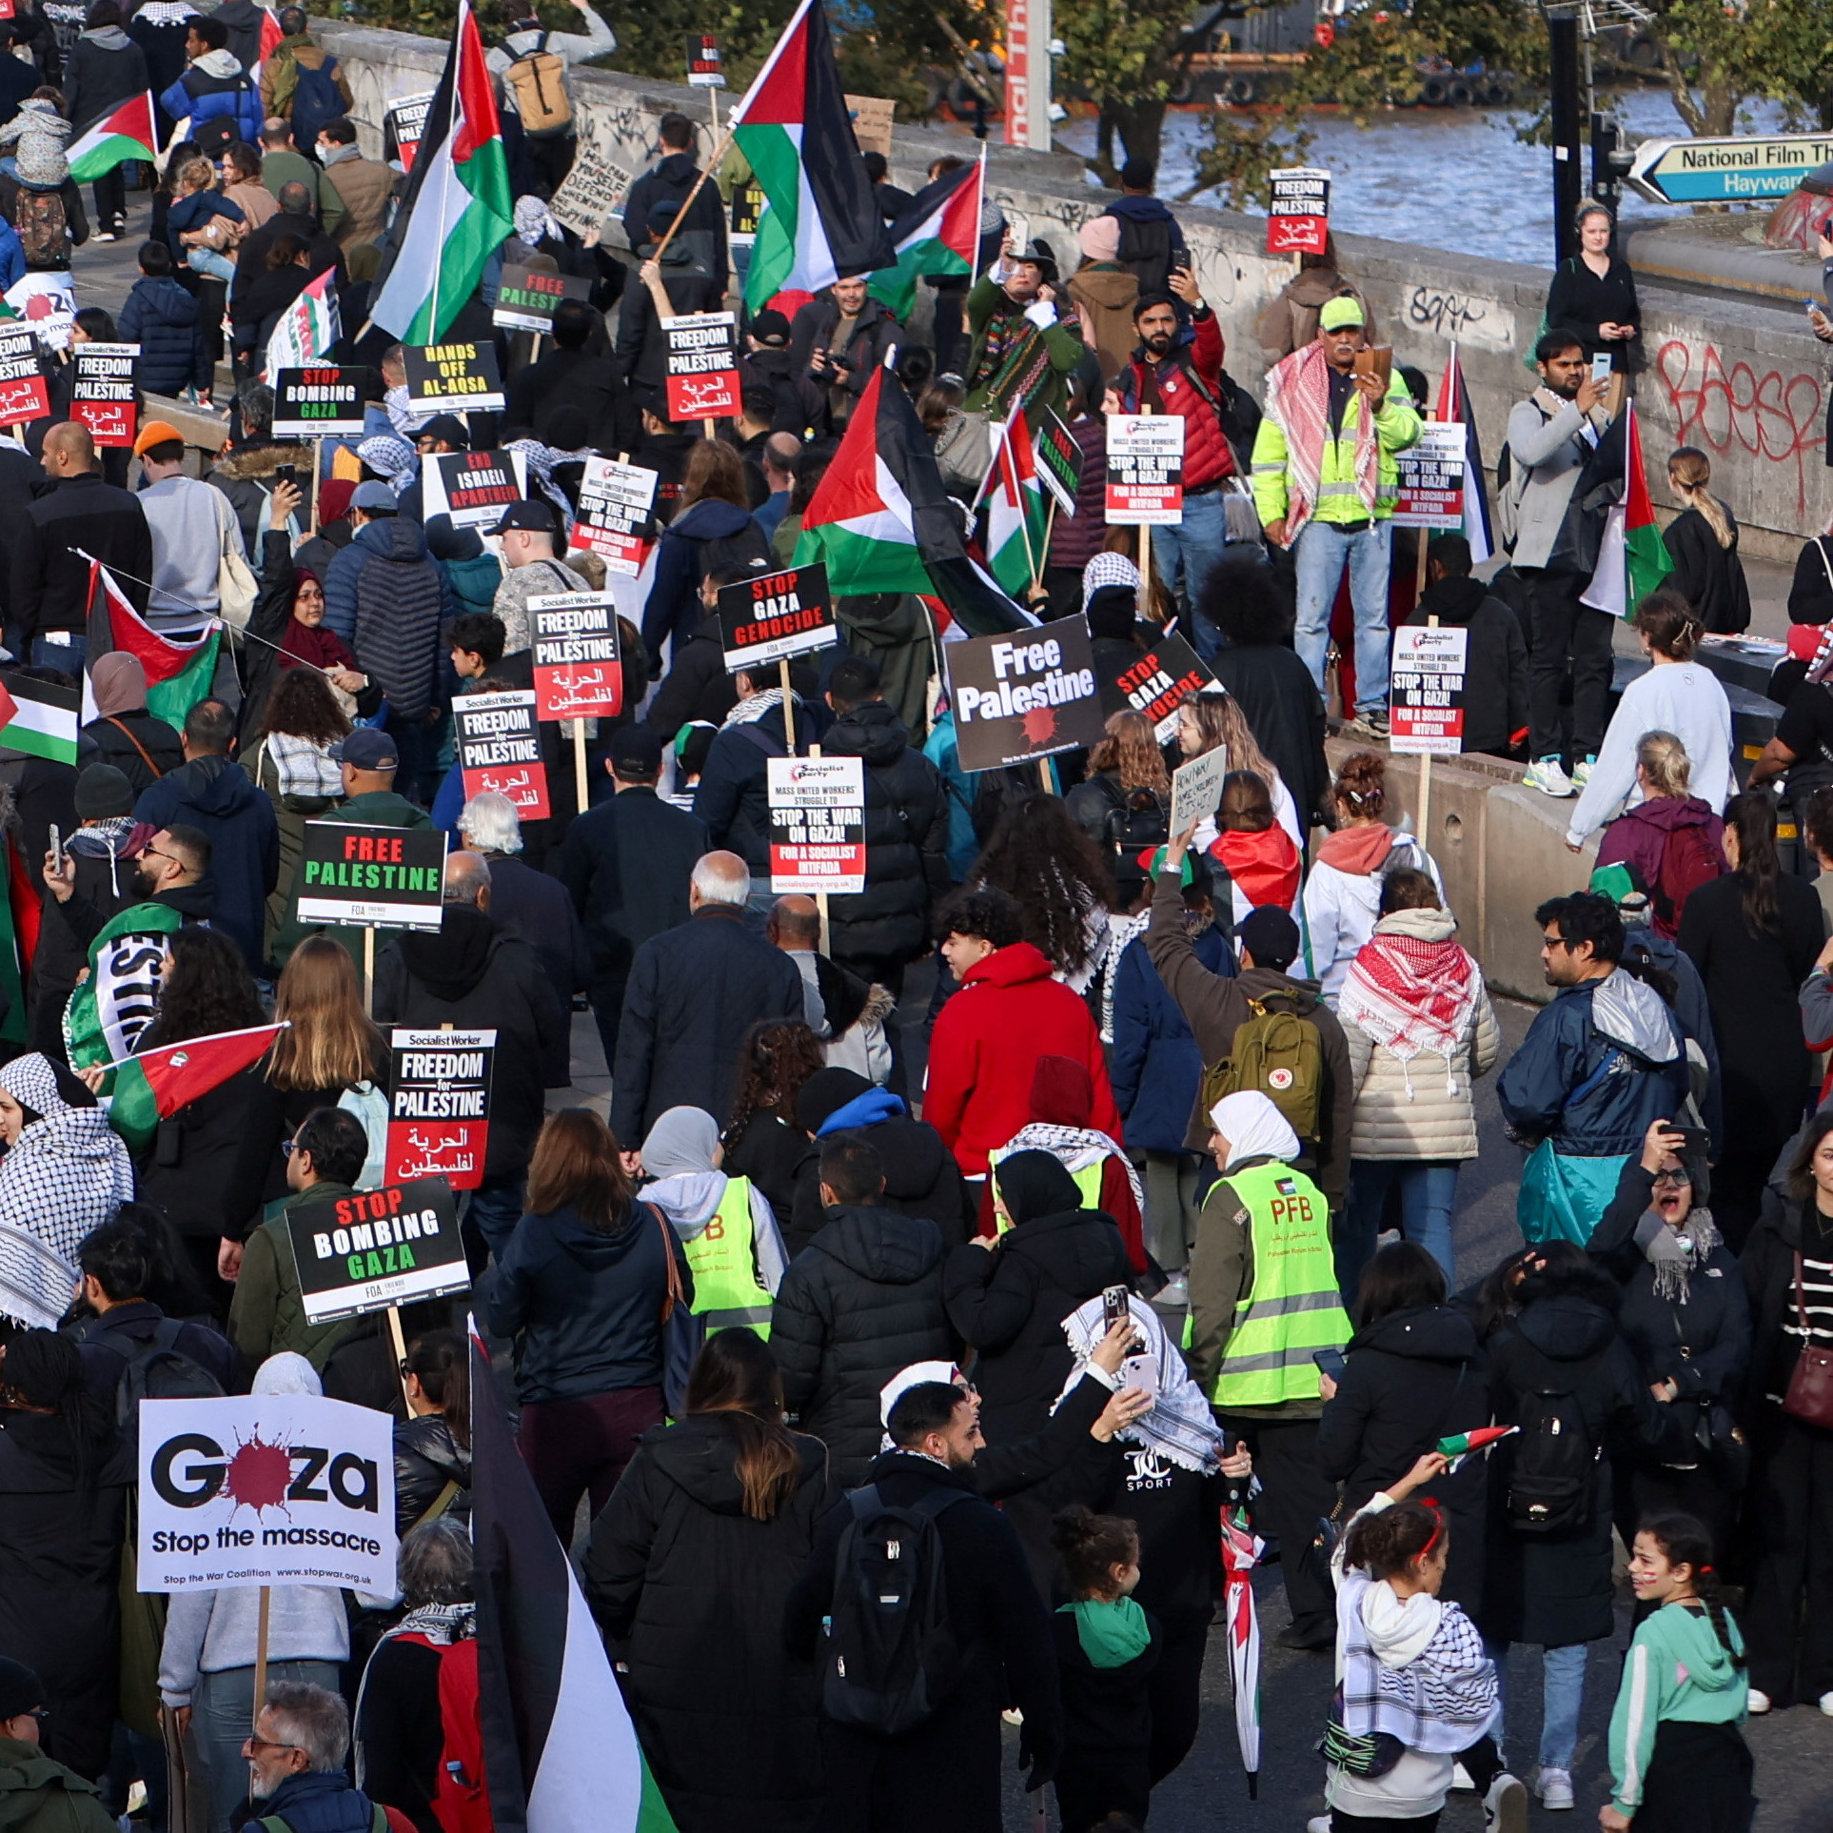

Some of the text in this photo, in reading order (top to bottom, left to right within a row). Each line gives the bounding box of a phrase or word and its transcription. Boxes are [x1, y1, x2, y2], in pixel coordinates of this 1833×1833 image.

[1682, 148, 1758, 169] National
[1766, 145, 1805, 163] Film
[424, 344, 477, 362] HANDS
[302, 368, 341, 384] STOP
[439, 361, 466, 378] OFF
[286, 385, 356, 402] BOMBING
[423, 376, 488, 396] AL-AQSA
[300, 402, 337, 418] GAZA
[751, 572, 799, 600] STOP
[753, 592, 802, 621] GAZA
[734, 606, 824, 646] GENOCIDE
[991, 639, 1061, 679] Free
[957, 668, 1095, 722] Palestine
[776, 787, 795, 795] MASS
[797, 787, 819, 795] UNITED
[794, 796, 838, 805] STRUGGLE TO
[773, 808, 862, 826] STOP THE WAR
[789, 826, 846, 843] ON GAZA!
[779, 846, 856, 860] FOR A SOCIALIST
[798, 861, 841, 875] INTIFADA
[335, 1188, 404, 1225] STOP
[1270, 1196, 1313, 1225] PFB
[313, 1209, 440, 1259] BOMBING
[347, 1244, 416, 1280] GAZA
[365, 1283, 383, 1300] FOA
[150, 1432, 379, 1514] Gza
[1127, 1476, 1174, 1492] SPORT
[152, 1527, 381, 1556] Stop the massacre
[164, 1567, 372, 1585] Stop the War Coalition www.stopwar.org.uk
